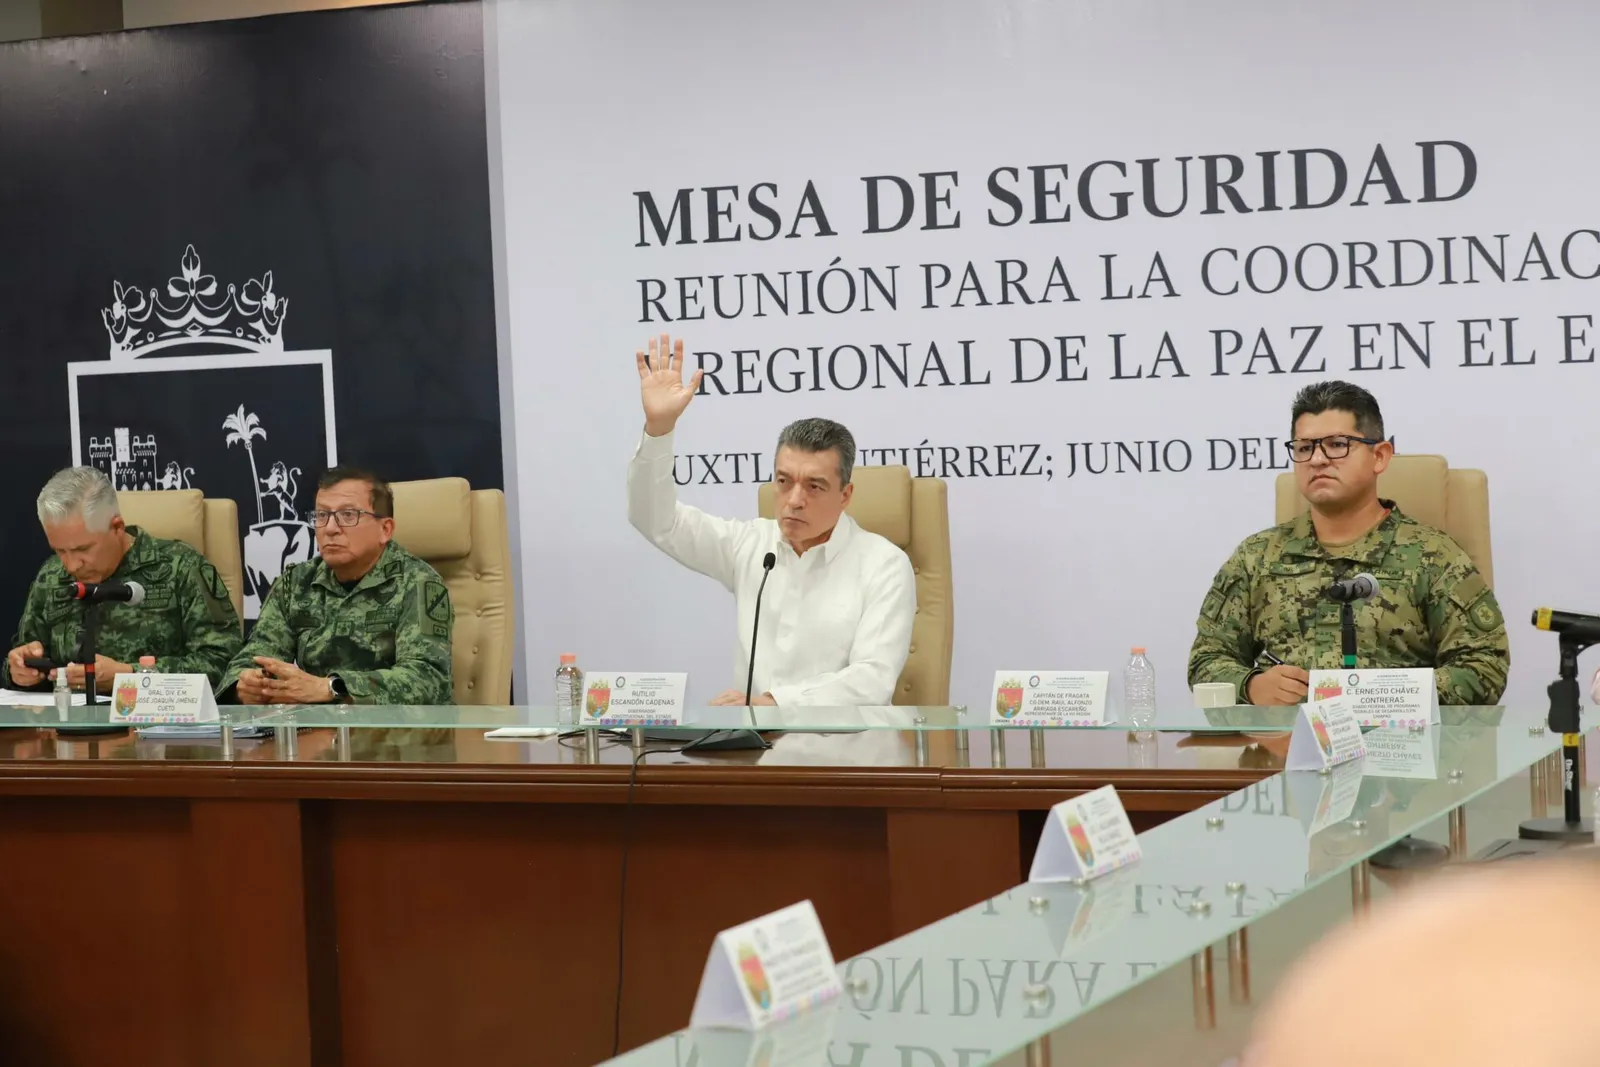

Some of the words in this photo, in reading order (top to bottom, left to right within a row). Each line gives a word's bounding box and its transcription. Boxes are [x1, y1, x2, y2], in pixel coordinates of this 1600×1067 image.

[633, 180, 837, 248] MESA
[860, 171, 961, 234] DE
[986, 140, 1478, 227] SEGURIDAD
[637, 257, 900, 323] REUNIÓN
[920, 256, 1080, 308] PARA
[1098, 251, 1181, 301] LA
[693, 340, 991, 395] REGIONAL
[1009, 335, 1088, 384] DE
[1108, 331, 1190, 380] LA
[1209, 325, 1327, 376] PAZ
[1348, 321, 1435, 371] EN
[1457, 317, 1536, 367] EL
[1557, 314, 1595, 364] E
[672, 452, 772, 486] UXTL
[859, 438, 1054, 481] TIÉRREZ;
[1067, 439, 1193, 478] JUNIO
[1206, 437, 1289, 471] DEL
[611, 698, 644, 706] ESCANDÓN
[645, 698, 675, 706] CADENAS
[1390, 686, 1420, 694] CHÁVEZ
